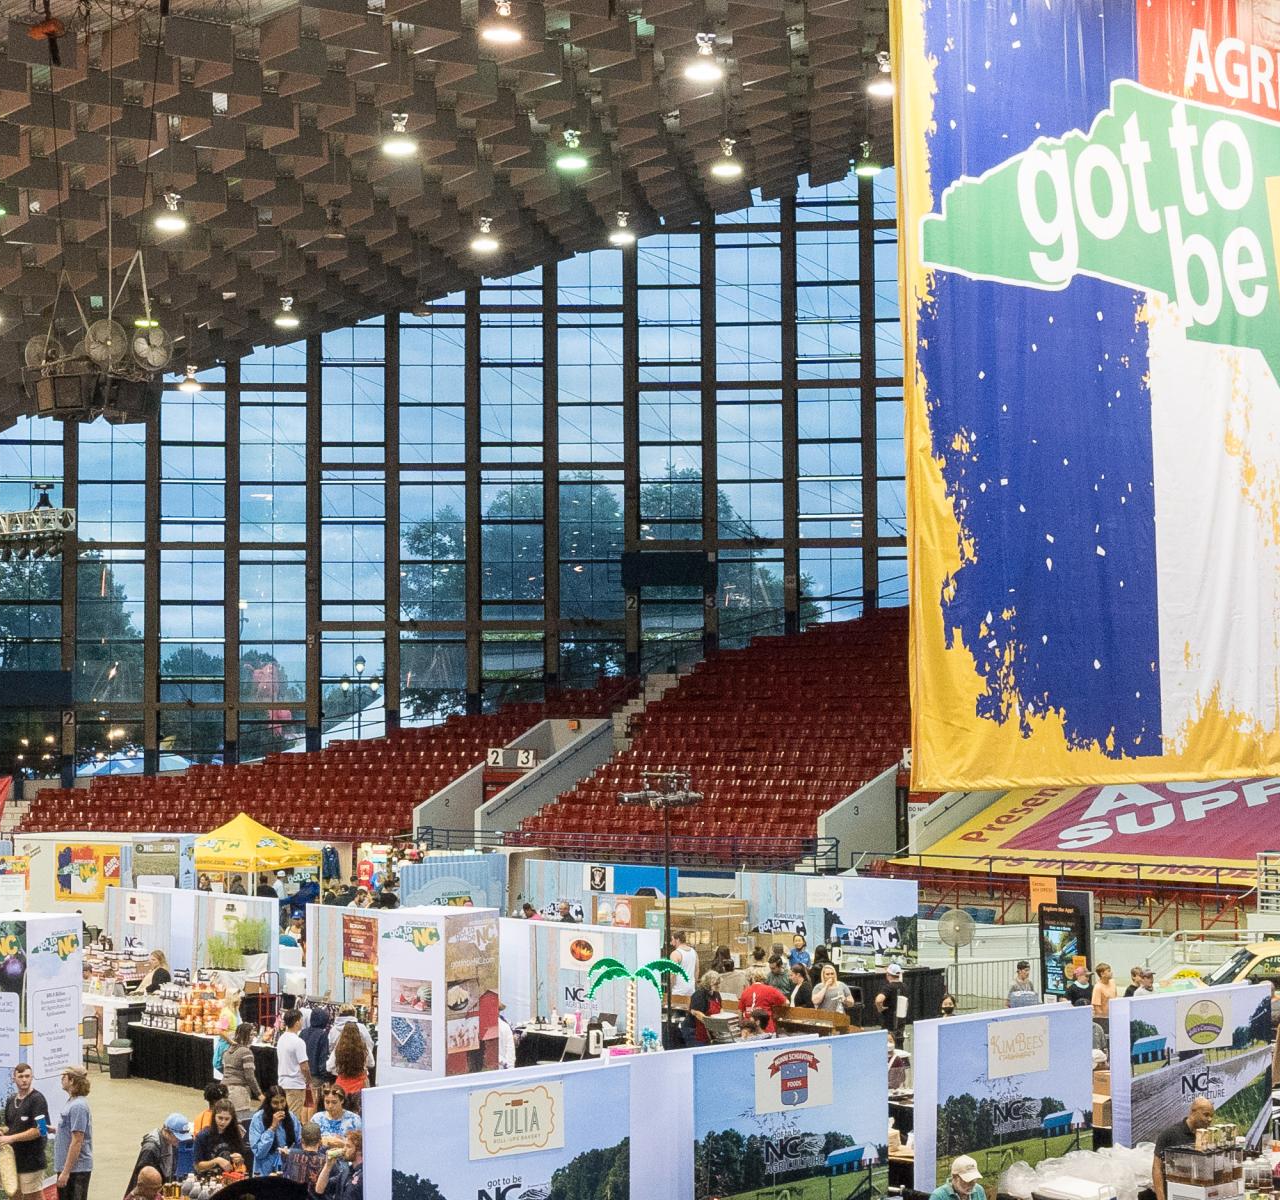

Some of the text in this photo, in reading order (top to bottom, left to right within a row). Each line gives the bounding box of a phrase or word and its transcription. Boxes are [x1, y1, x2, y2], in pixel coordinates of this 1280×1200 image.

[1017, 101, 1254, 282] got to
[1166, 205, 1268, 328] be
[627, 596, 636, 609] 2
[64, 712, 73, 725] 2
[491, 750, 500, 765] 2
[521, 750, 530, 765] 3
[854, 806, 859, 815] 3
[389, 928, 403, 938] got
[758, 921, 772, 934] got
[848, 926, 871, 941] got to
[125, 937, 138, 948] NC
[412, 928, 438, 947] NC
[862, 933, 872, 943] be
[873, 929, 897, 949] NC
[57, 934, 77, 957] NC
[565, 987, 585, 1002] NC
[787, 1080, 802, 1088] FOODS
[1181, 1073, 1208, 1095] NC
[993, 1100, 1024, 1124] NC
[493, 1106, 540, 1137] ZULIA
[763, 1136, 802, 1164] NC
[765, 1155, 826, 1175] AGRICULTURE
[487, 1174, 522, 1190] got to be
